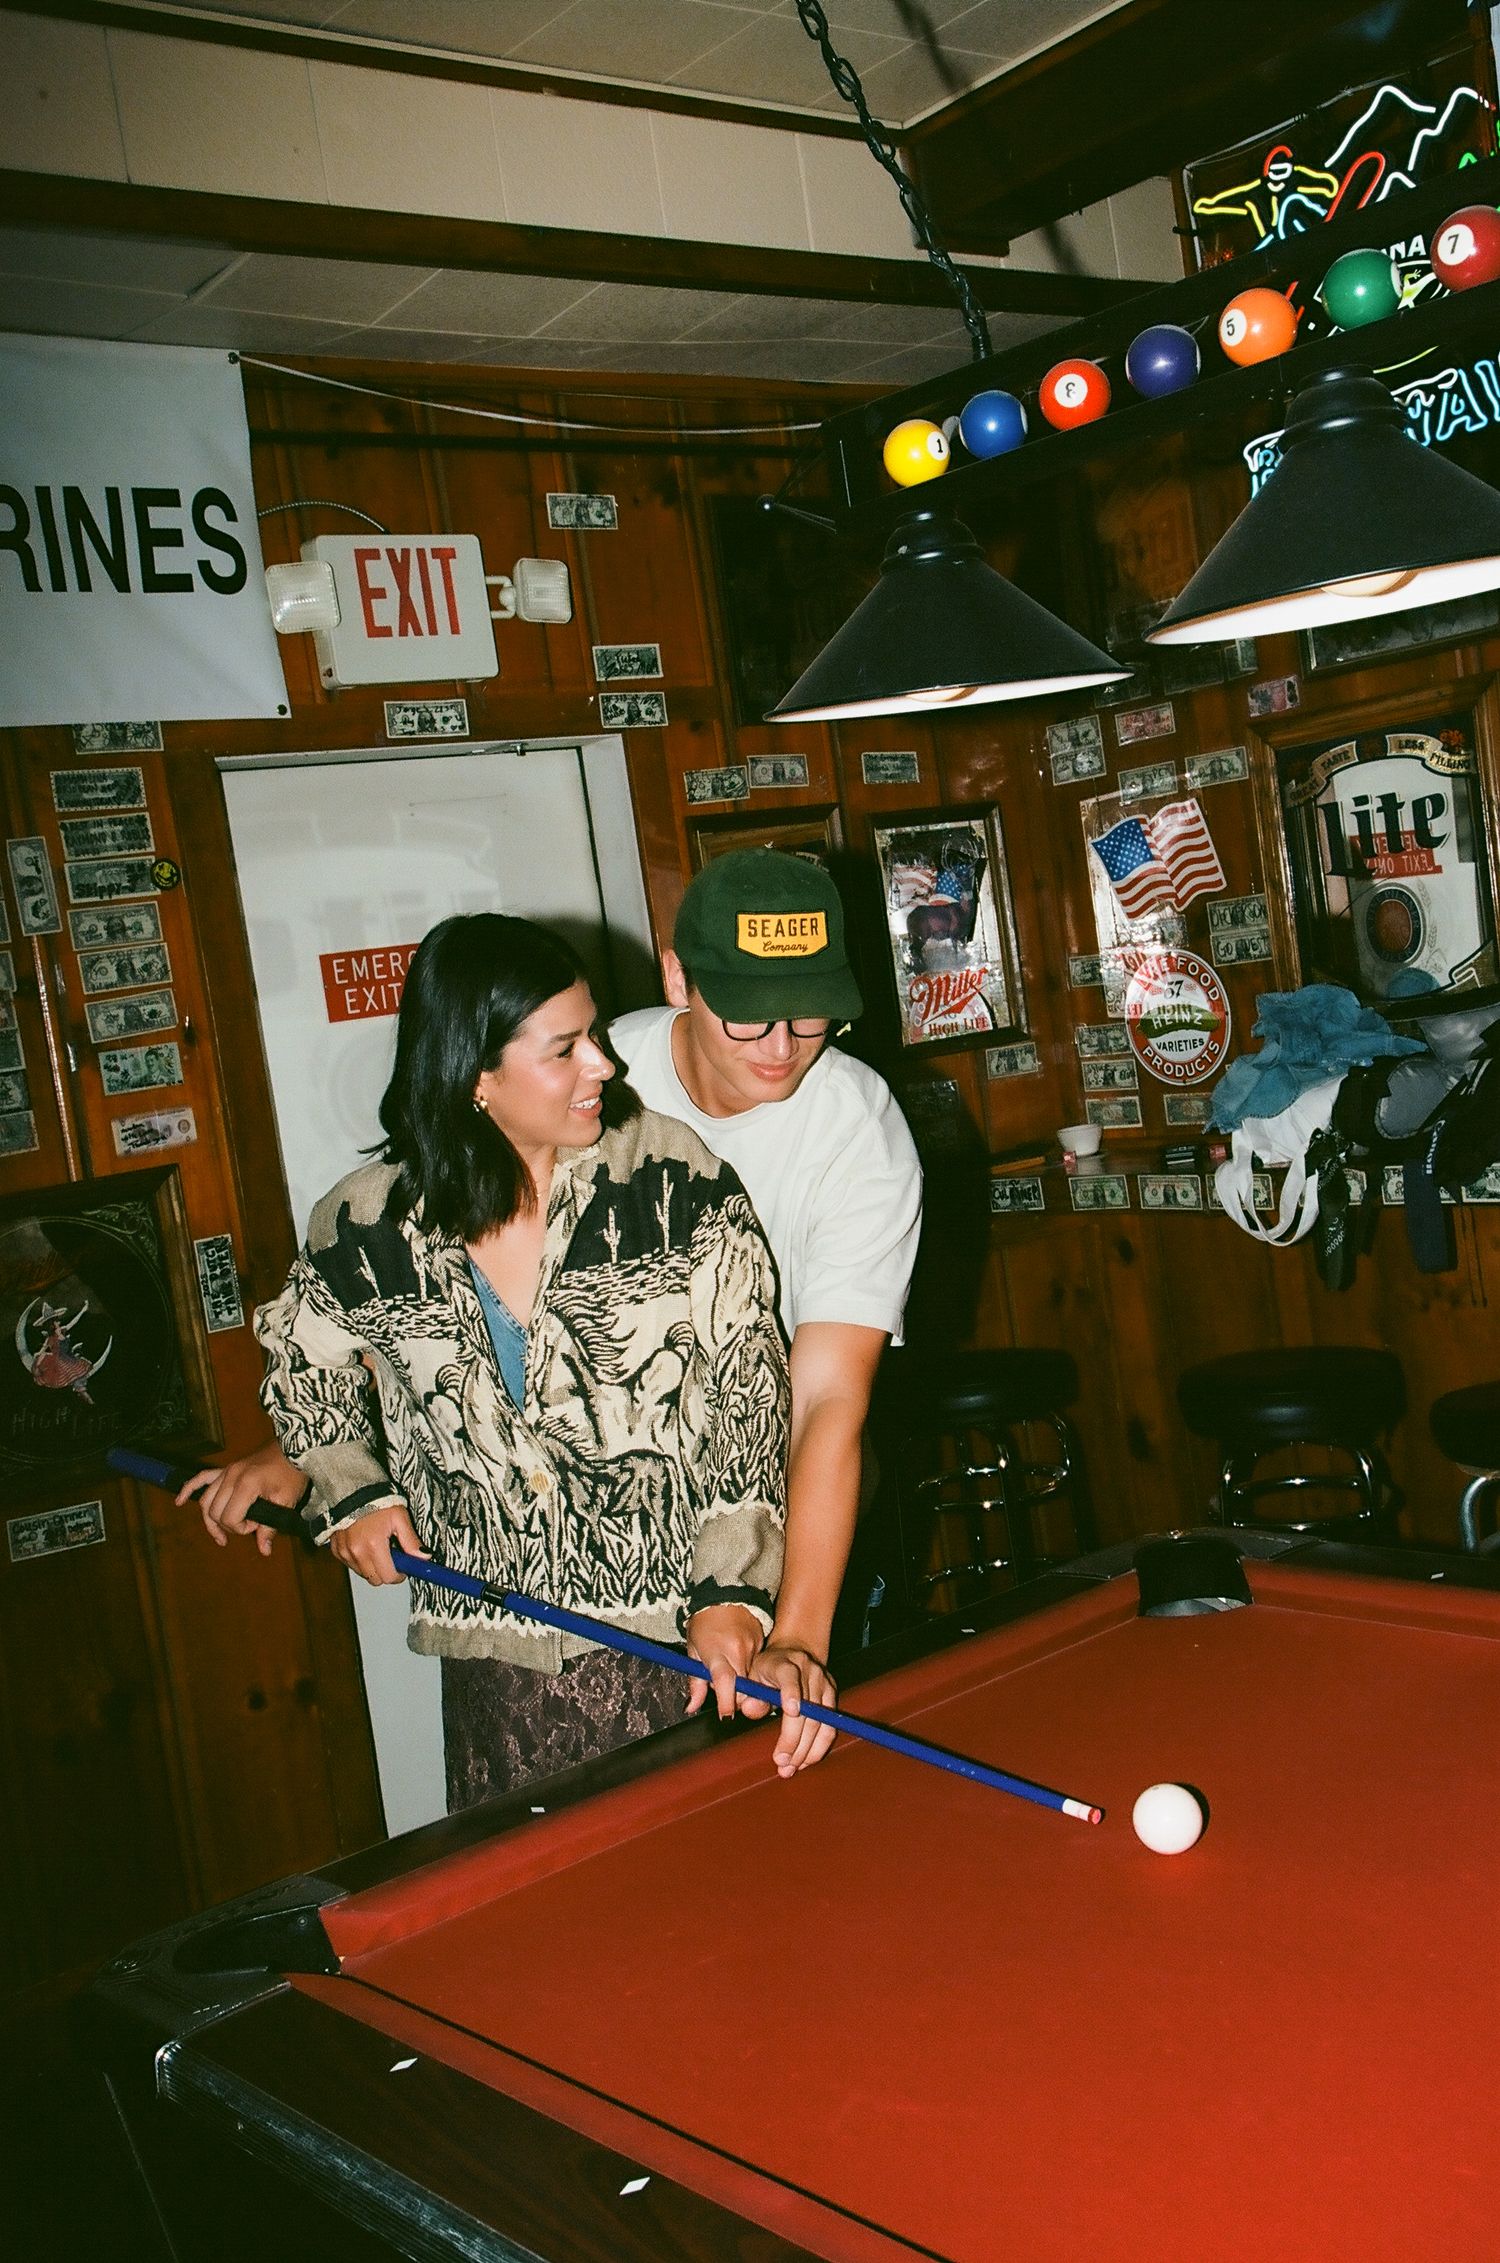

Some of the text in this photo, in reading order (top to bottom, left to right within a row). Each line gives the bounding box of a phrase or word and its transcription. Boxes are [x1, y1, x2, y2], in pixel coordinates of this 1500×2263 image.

[1447, 233, 1459, 255] 7
[1226, 320, 1235, 336] 5
[0, 484, 247, 595] RINES
[354, 548, 461, 638] EXIT
[1321, 751, 1350, 769] TASTE
[1398, 739, 1471, 770] LESS FILLING
[1317, 792, 1450, 881] Lite
[747, 917, 819, 938] SEAGER
[763, 941, 808, 953] Company
[1217, 941, 1233, 958] GO
[1164, 980, 1184, 999] 57
[1177, 957, 1220, 1001] FOOD
[345, 982, 402, 1015] EXIT
[909, 967, 989, 1021] Miller
[929, 1022, 959, 1037] HIGH
[1152, 1011, 1203, 1030] HEINZ
[1156, 1038, 1205, 1053] VARIETIES
[1143, 1040, 1220, 1077] PRODUCTS
